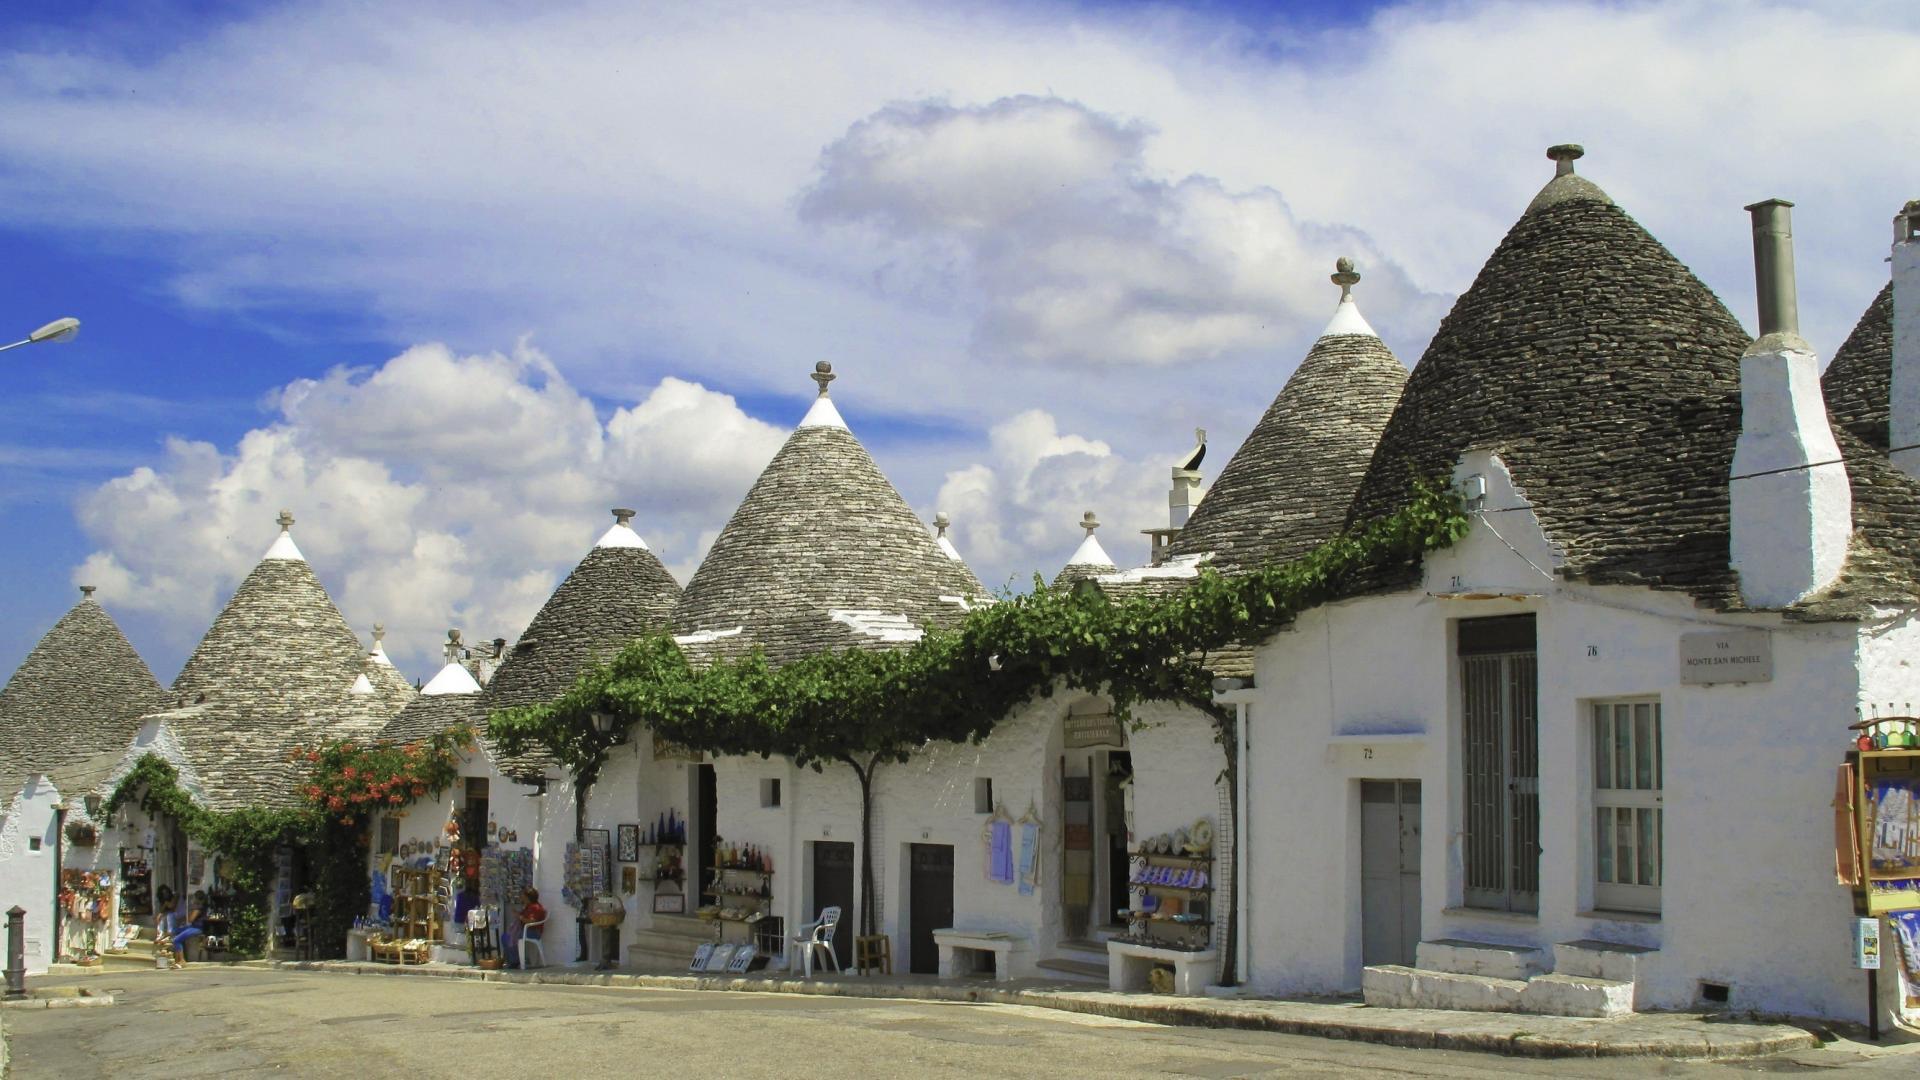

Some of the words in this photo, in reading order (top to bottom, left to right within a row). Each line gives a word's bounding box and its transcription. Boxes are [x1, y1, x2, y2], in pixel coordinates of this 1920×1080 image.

[1716, 641, 1729, 649] VIA
[1587, 645, 1598, 657] 76
[1687, 657, 1712, 666] MONTE
[1713, 656, 1729, 665] SAN
[1730, 655, 1761, 664] MICHELE
[1363, 747, 1373, 760] 72
